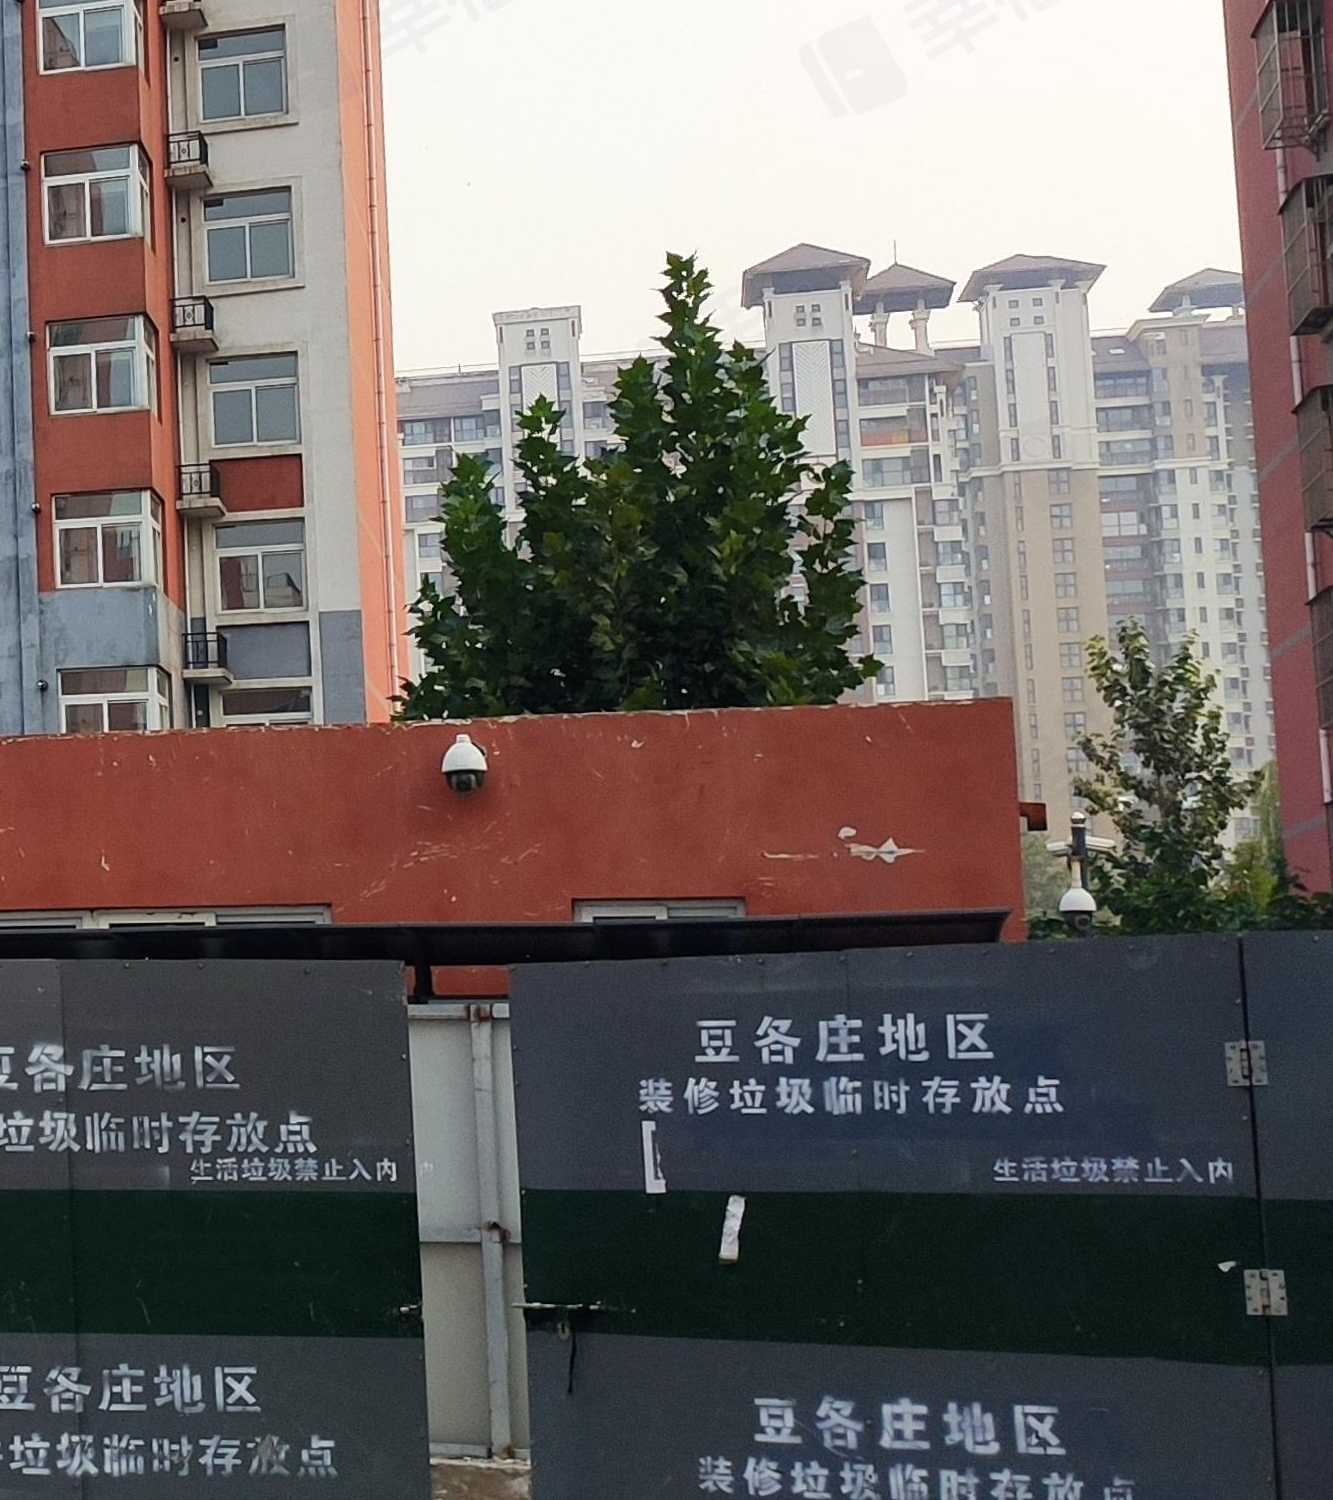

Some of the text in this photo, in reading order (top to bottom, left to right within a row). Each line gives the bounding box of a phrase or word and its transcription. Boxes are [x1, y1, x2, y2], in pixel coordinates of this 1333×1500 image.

[694, 1012, 995, 1066] 豆各庄地区
[638, 1076, 1064, 1116] 装修垃圾临时存放点
[190, 1158, 397, 1184] 生活垃圾禁止入内
[993, 1155, 1233, 1185] 生活垃圾禁止入内
[754, 1396, 1067, 1456] 豆各庄地区
